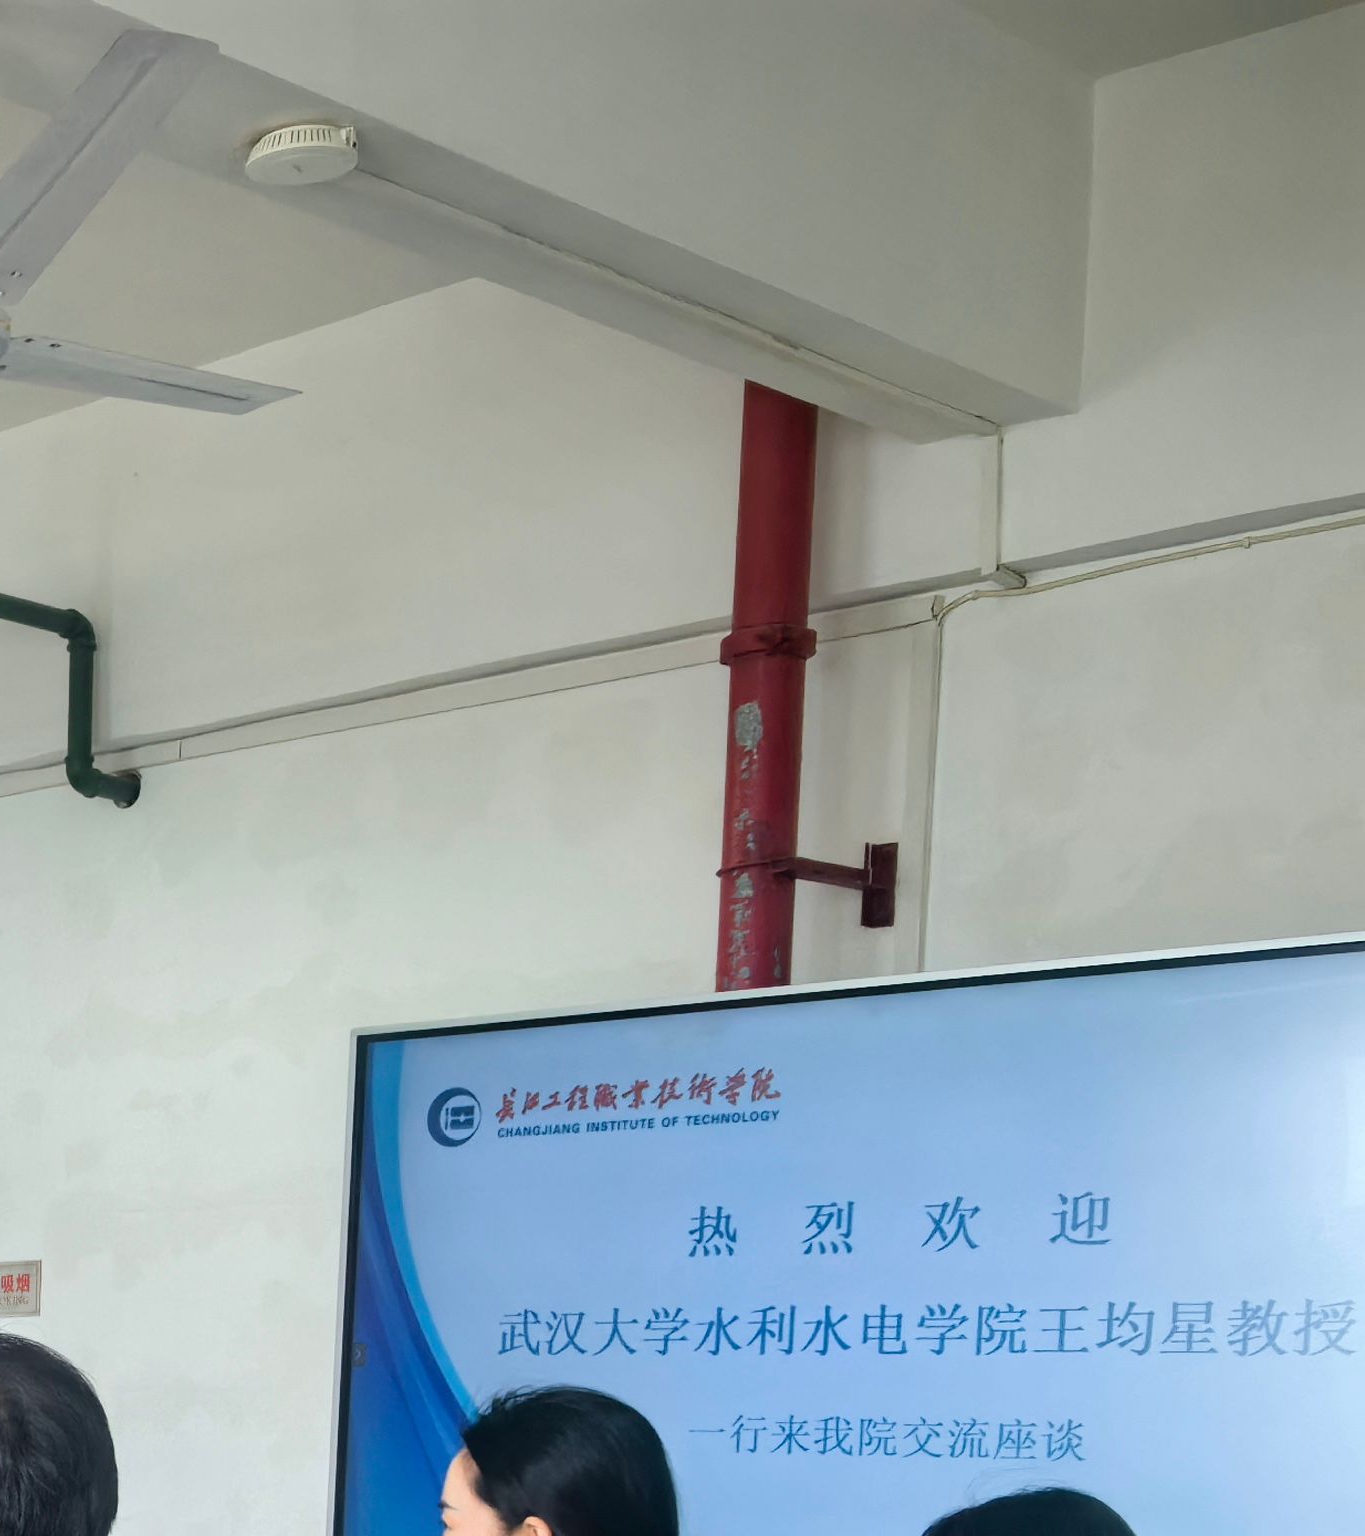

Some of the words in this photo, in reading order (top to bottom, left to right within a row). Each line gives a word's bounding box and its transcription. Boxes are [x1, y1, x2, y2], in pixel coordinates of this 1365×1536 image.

[497, 1122, 581, 1138] CHANGJIANG
[586, 1118, 655, 1132] INSTITUTE
[661, 1116, 679, 1128] OF
[685, 1110, 780, 1126] TECHNOLOGY
[687, 1191, 1112, 1258] 热烈欢迎
[497, 1298, 1357, 1358] 武汉大学水利水电学院王均星教授
[687, 1413, 1087, 1463] 一行来我院交流座谈
